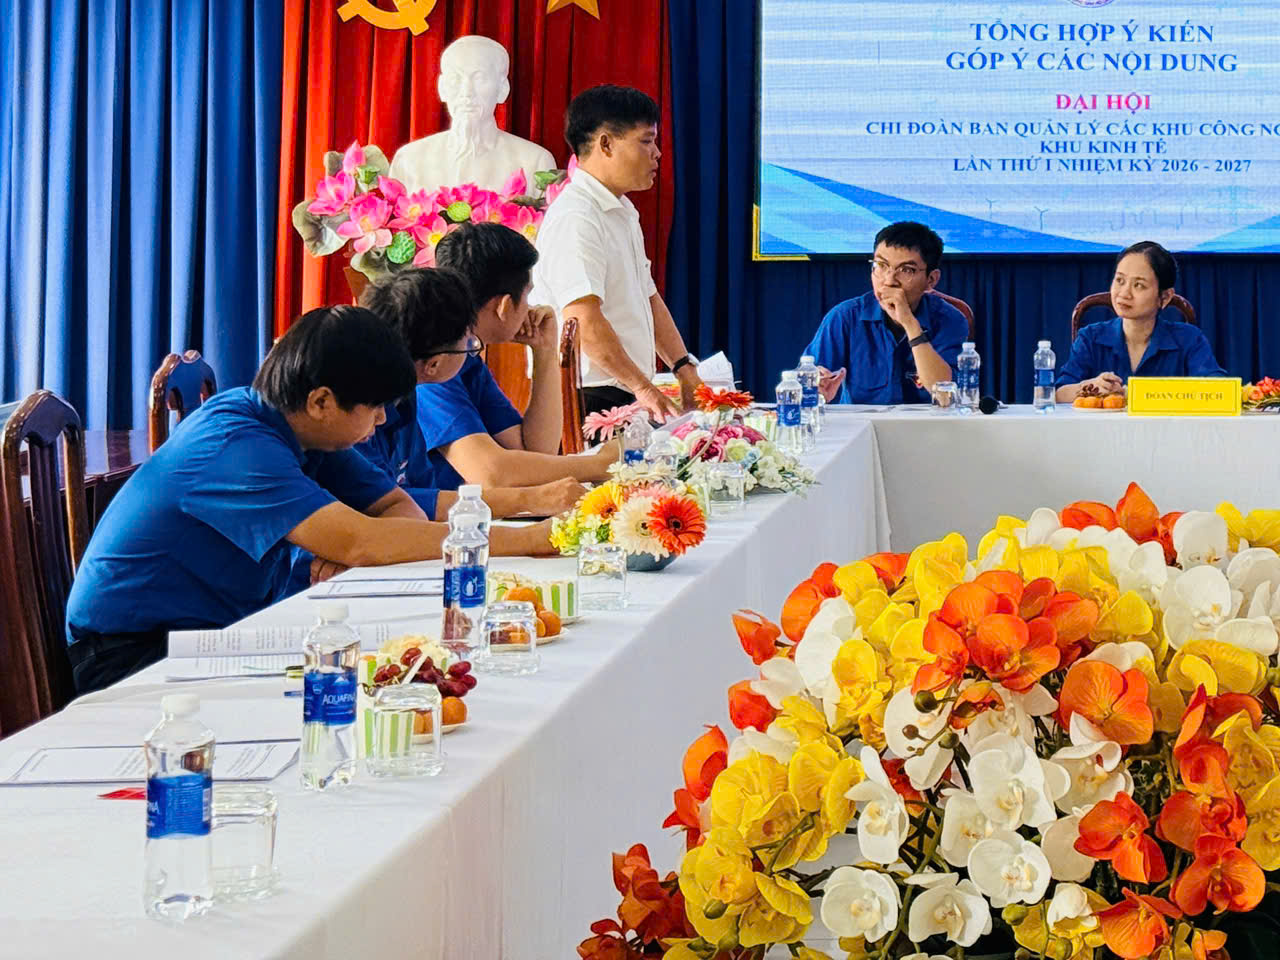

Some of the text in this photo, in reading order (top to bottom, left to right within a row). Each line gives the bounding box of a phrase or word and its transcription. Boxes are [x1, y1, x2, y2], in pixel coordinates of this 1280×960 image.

[969, 19, 1215, 46] TỔNG HỢP Ý KIẾN
[946, 47, 1238, 75] GÓP Ý CÁC NỘI DUNG
[1055, 91, 1152, 115] ĐẠI HỘI
[866, 121, 901, 135] CHI
[908, 119, 963, 135] ĐOÀN
[970, 122, 1008, 135] BAN
[1014, 119, 1069, 138] QUẢN
[1076, 119, 1100, 135] LÝ
[1106, 119, 1147, 136] CÁC
[1152, 123, 1193, 136] KHU
[1199, 120, 1254, 136] CÔNG
[1040, 141, 1081, 154] KHU
[1088, 140, 1137, 154] KINH
[1000, 155, 1041, 172] THỨ
[1046, 158, 1051, 171] I
[1056, 158, 1122, 175] NHIỆM
[1161, 159, 1199, 172] 2026
[1214, 159, 1252, 172] 2027
